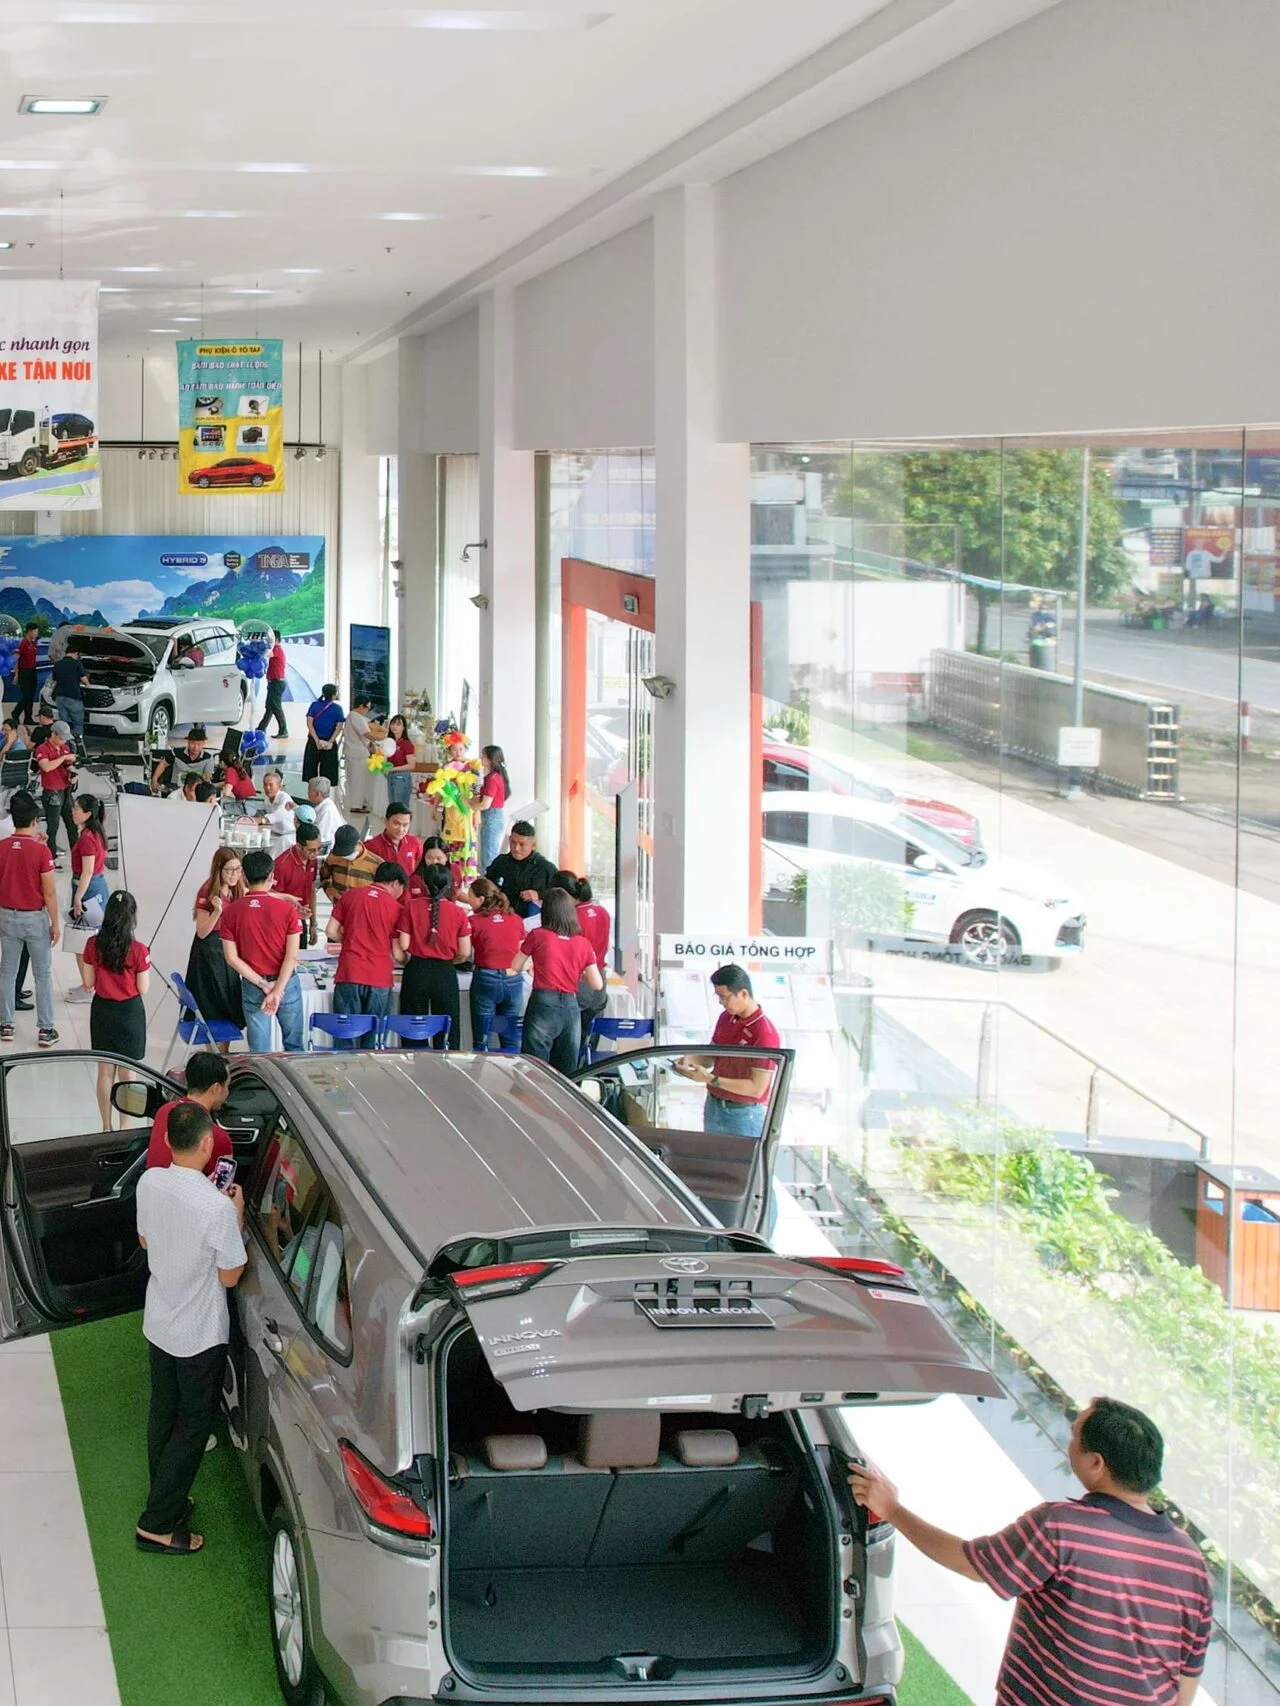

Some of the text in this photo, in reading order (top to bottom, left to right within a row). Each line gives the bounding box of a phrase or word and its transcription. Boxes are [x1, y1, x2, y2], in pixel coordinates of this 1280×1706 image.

[10, 337, 59, 351] nhanh
[61, 340, 90, 354] gọn
[23, 357, 57, 384] TẬN
[61, 359, 91, 381] NƠI
[674, 940, 816, 960] BÁO GIÁ TỔNG HỢP
[648, 1307, 710, 1315] INNOVA
[487, 1328, 563, 1346] INNOVA
